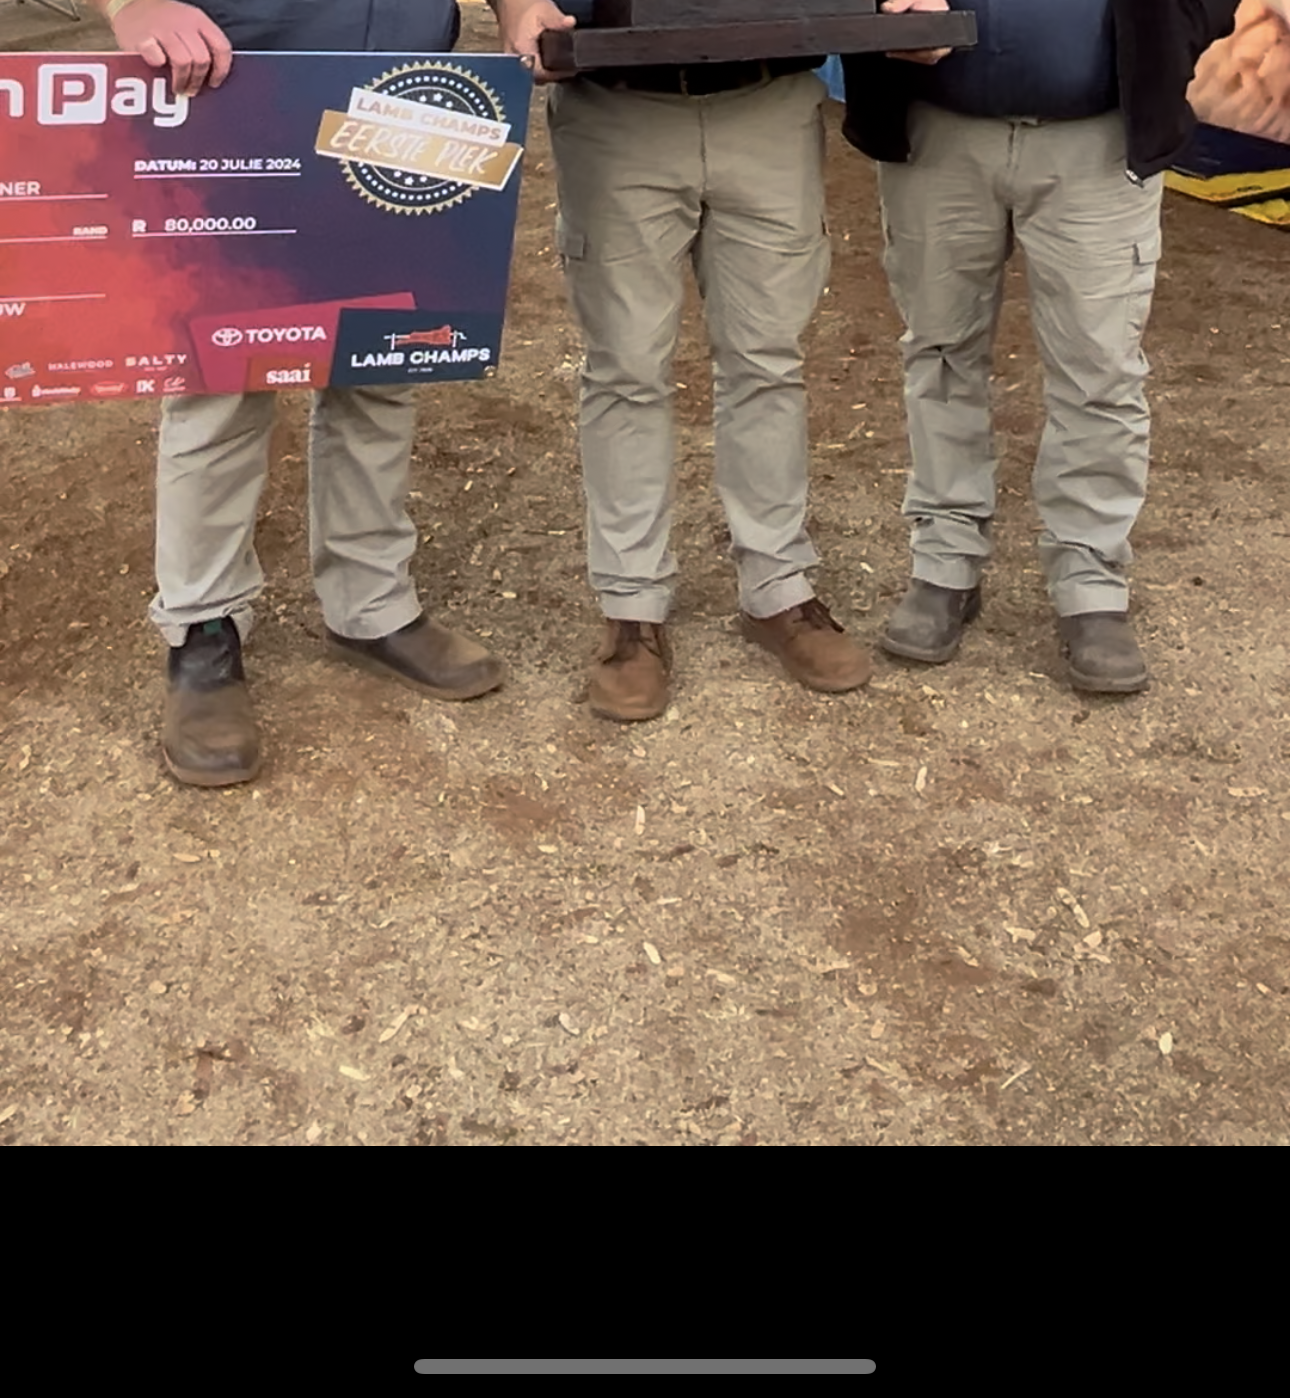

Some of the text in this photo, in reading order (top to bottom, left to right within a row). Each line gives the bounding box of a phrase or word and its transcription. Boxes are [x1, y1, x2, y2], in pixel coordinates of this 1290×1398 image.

[37, 63, 190, 128] Pay
[356, 97, 502, 142] LAMB CHAMPS
[134, 158, 302, 172] DATUM: 20 JULIE 2024
[132, 217, 257, 233] R 80,000.00
[246, 326, 327, 344] TOYOTA
[351, 347, 491, 368] LAMB CHAMPS
